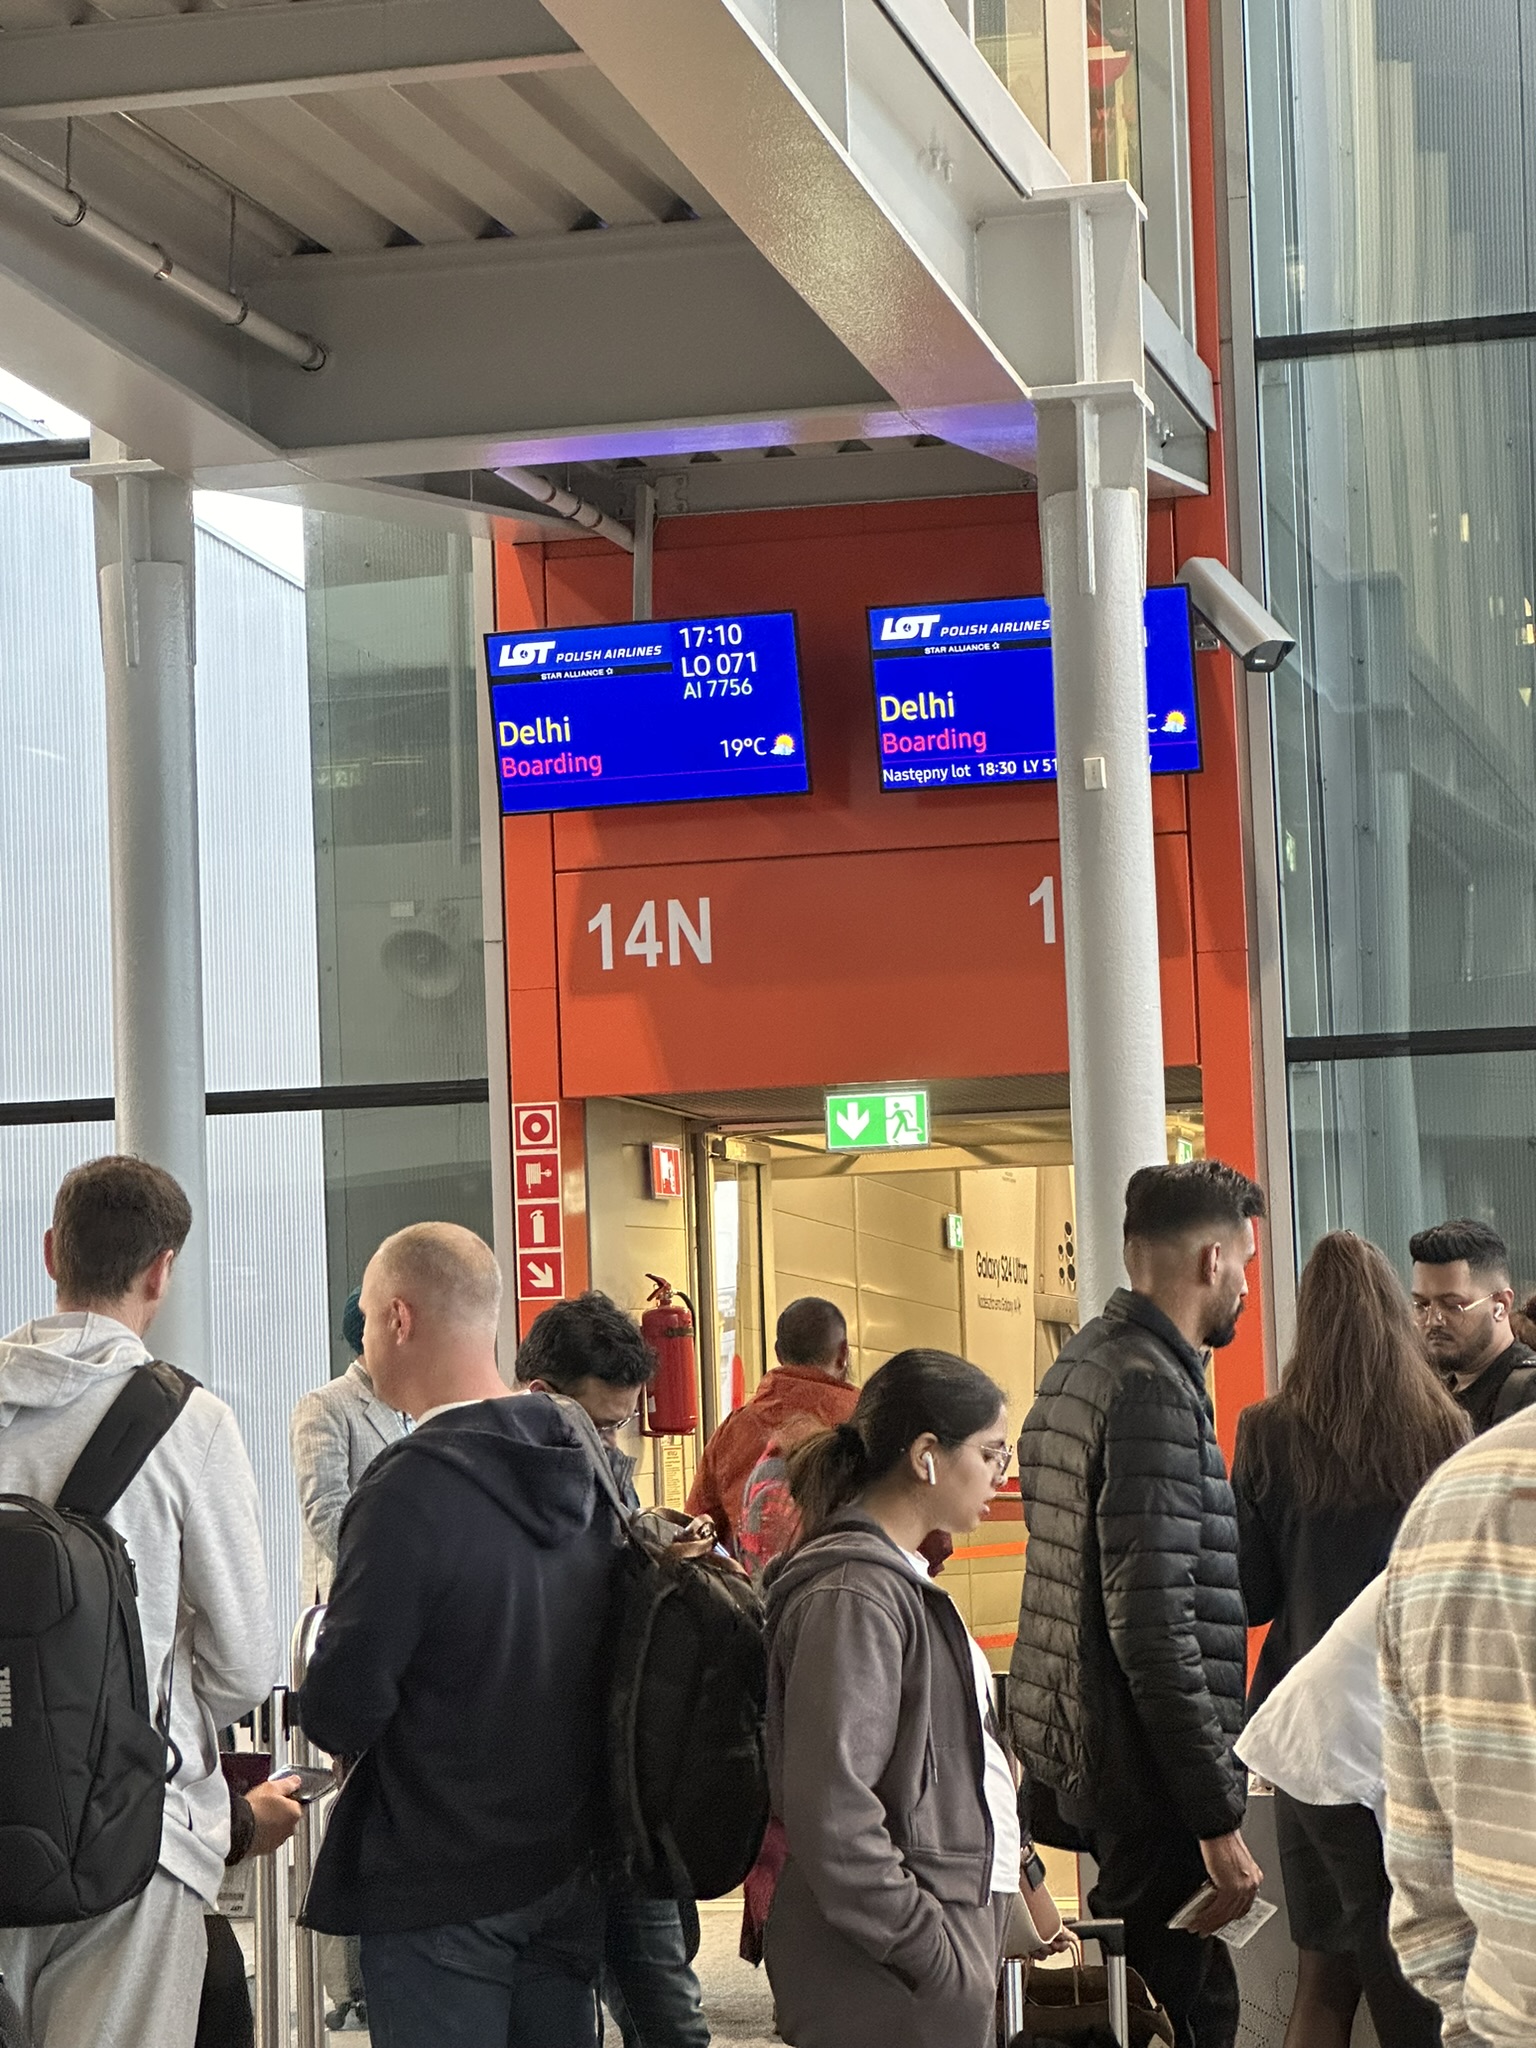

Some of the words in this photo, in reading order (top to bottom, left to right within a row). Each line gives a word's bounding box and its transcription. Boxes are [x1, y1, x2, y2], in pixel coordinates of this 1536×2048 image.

[679, 623, 742, 649] 17:10
[882, 614, 941, 640] LOT
[940, 624, 988, 637] POLISH
[990, 619, 1051, 634] AIRLINES
[499, 641, 556, 667] LOT
[556, 649, 601, 663] POLISH
[604, 645, 662, 659] AIRLINES
[924, 646, 947, 655] STAR
[948, 642, 991, 653] ALLIANCE
[540, 672, 562, 681] STAR
[564, 668, 605, 679] ALLIANCE
[681, 656, 711, 678] LO
[716, 651, 757, 675] 071
[683, 681, 702, 700] AI
[706, 677, 753, 698] 7756
[880, 691, 955, 722] Delhi
[499, 716, 571, 746] Delhi
[883, 728, 987, 754] Boarding
[502, 752, 602, 778] Boarding
[882, 768, 949, 783] Następny
[951, 764, 972, 778] lot
[978, 761, 1017, 776] 18:30
[1023, 759, 1040, 774] LY
[587, 896, 713, 971] 14N
[976, 1250, 1001, 1288] Galaxy
[1001, 1254, 1012, 1283] S24
[1013, 1256, 1028, 1285] Ultra
